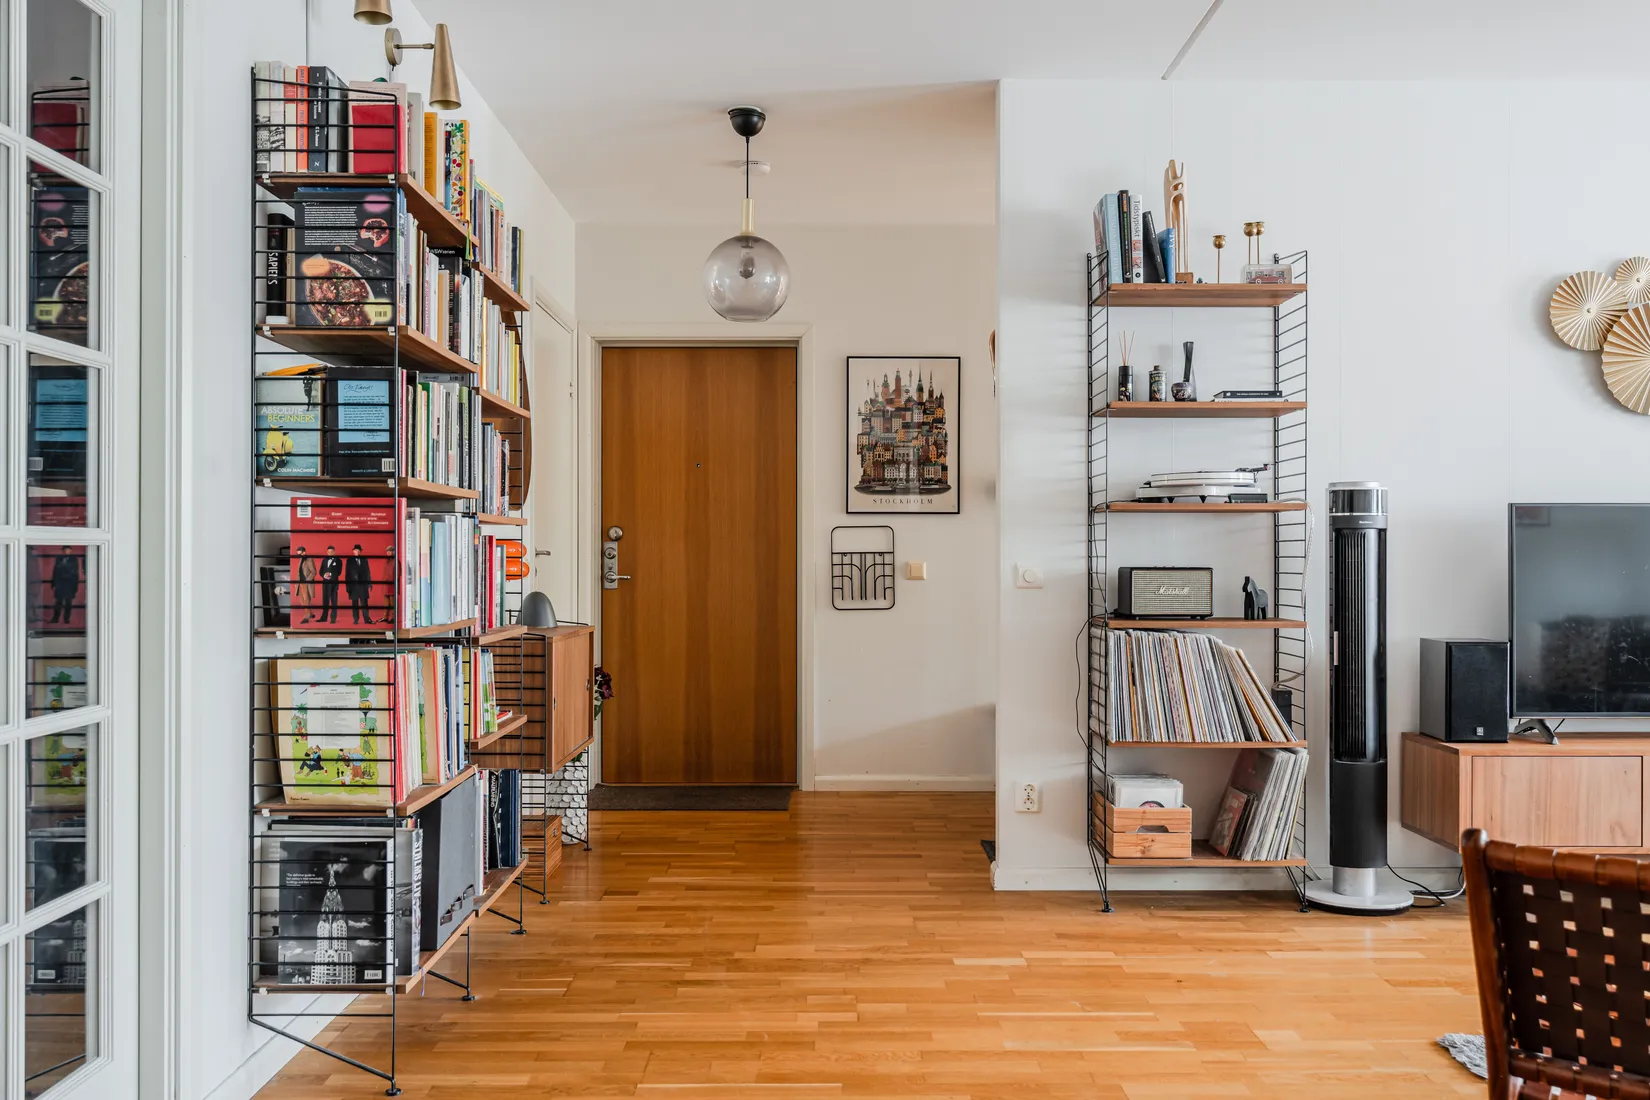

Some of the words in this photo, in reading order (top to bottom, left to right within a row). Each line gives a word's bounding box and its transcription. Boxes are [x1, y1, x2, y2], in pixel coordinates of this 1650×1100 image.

[261, 406, 304, 414] ABSOLUTE
[268, 414, 315, 422] BEGINNERS
[1156, 586, 1190, 595] Marshall
